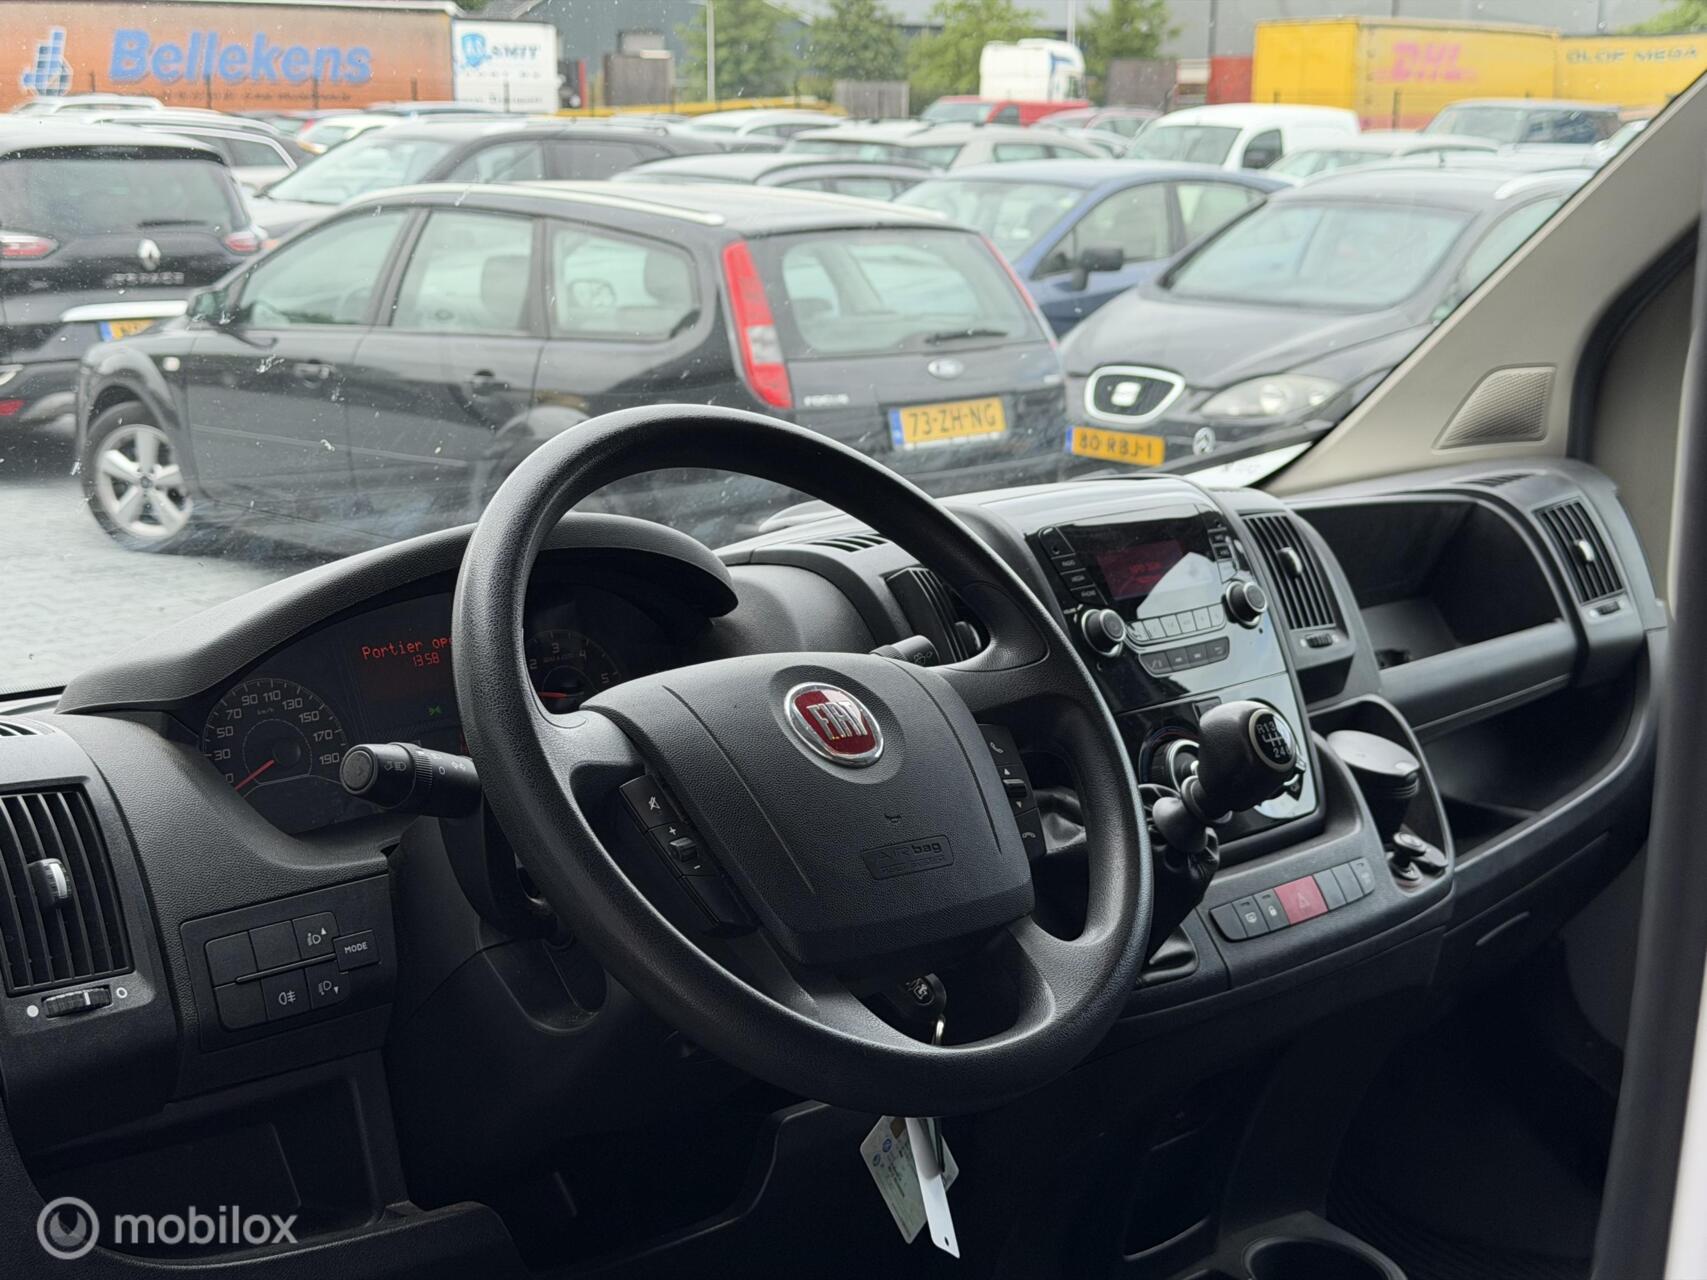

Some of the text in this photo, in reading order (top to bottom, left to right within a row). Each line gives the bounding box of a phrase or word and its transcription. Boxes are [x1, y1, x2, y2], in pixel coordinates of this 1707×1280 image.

[110, 28, 374, 86] Bellekens
[361, 641, 423, 660] Portier
[241, 694, 259, 706] 90
[262, 690, 282, 702] 110
[282, 697, 304, 711] 130
[225, 708, 243, 720] 70
[298, 710, 321, 724] 150
[806, 700, 868, 741] FIAT
[217, 725, 234, 738] 50
[313, 729, 334, 742] 170
[213, 748, 231, 761] 30
[320, 752, 341, 766] 190
[344, 940, 369, 954] MODE
